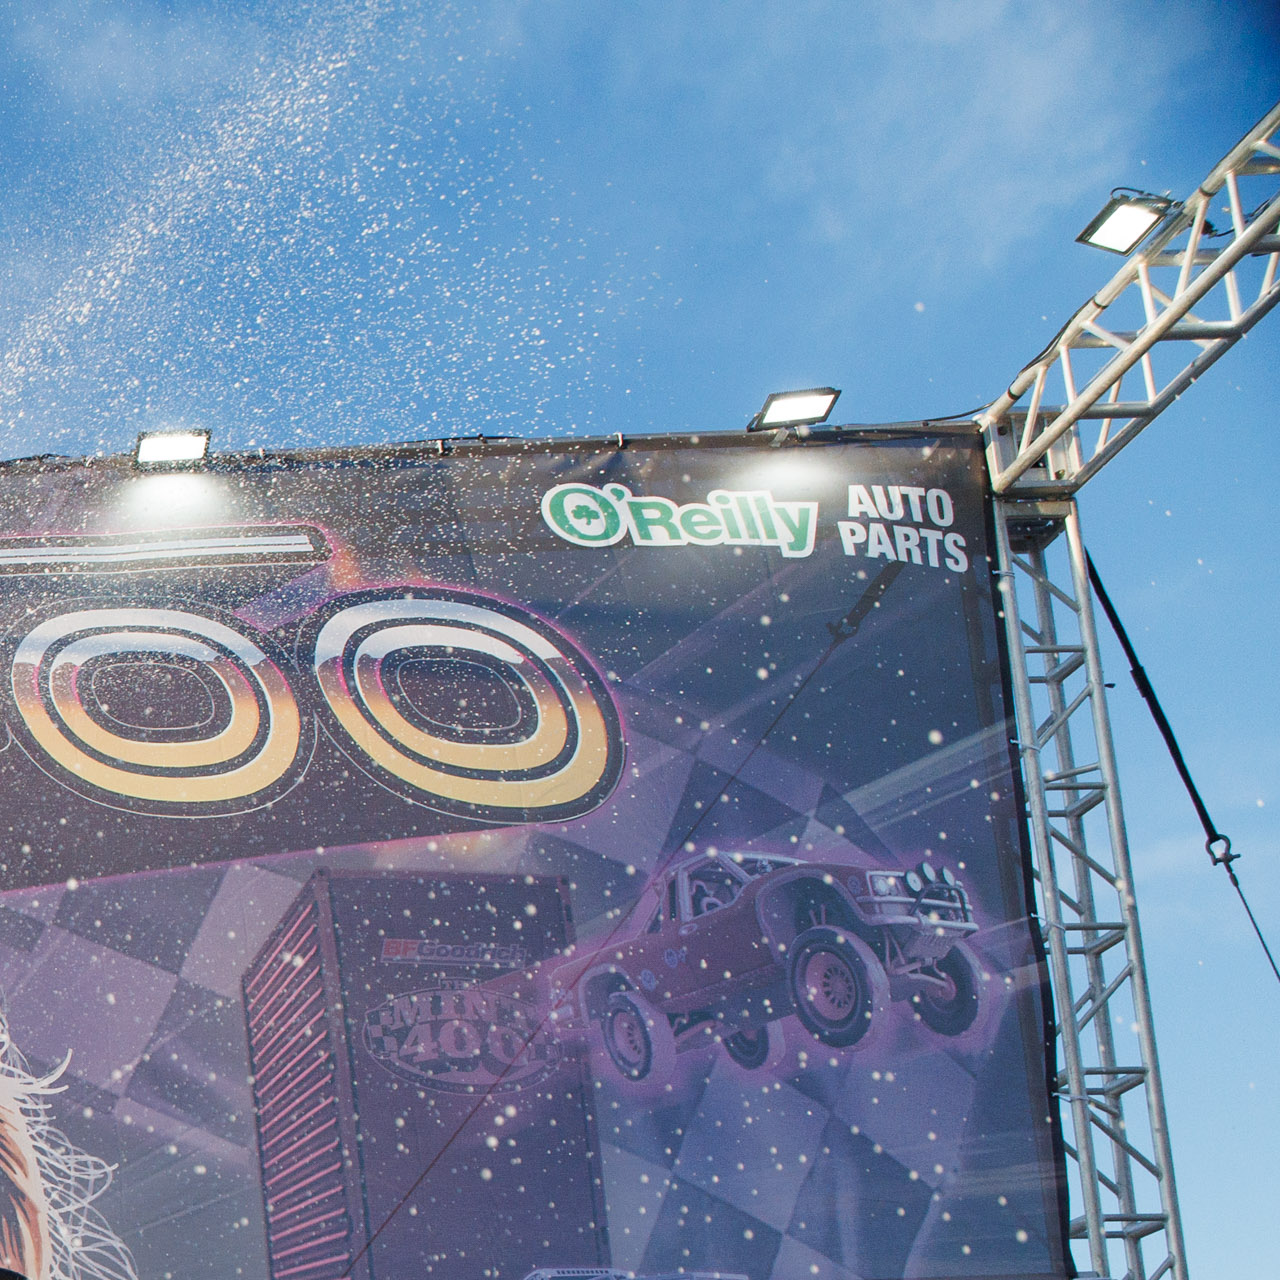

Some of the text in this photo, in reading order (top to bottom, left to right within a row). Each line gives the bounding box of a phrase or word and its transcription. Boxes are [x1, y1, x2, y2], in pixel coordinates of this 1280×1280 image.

[545, 484, 812, 555] O'Reilly
[847, 484, 954, 526] AUTO
[838, 521, 968, 573] PARTS
[398, 1020, 529, 1067] 400
